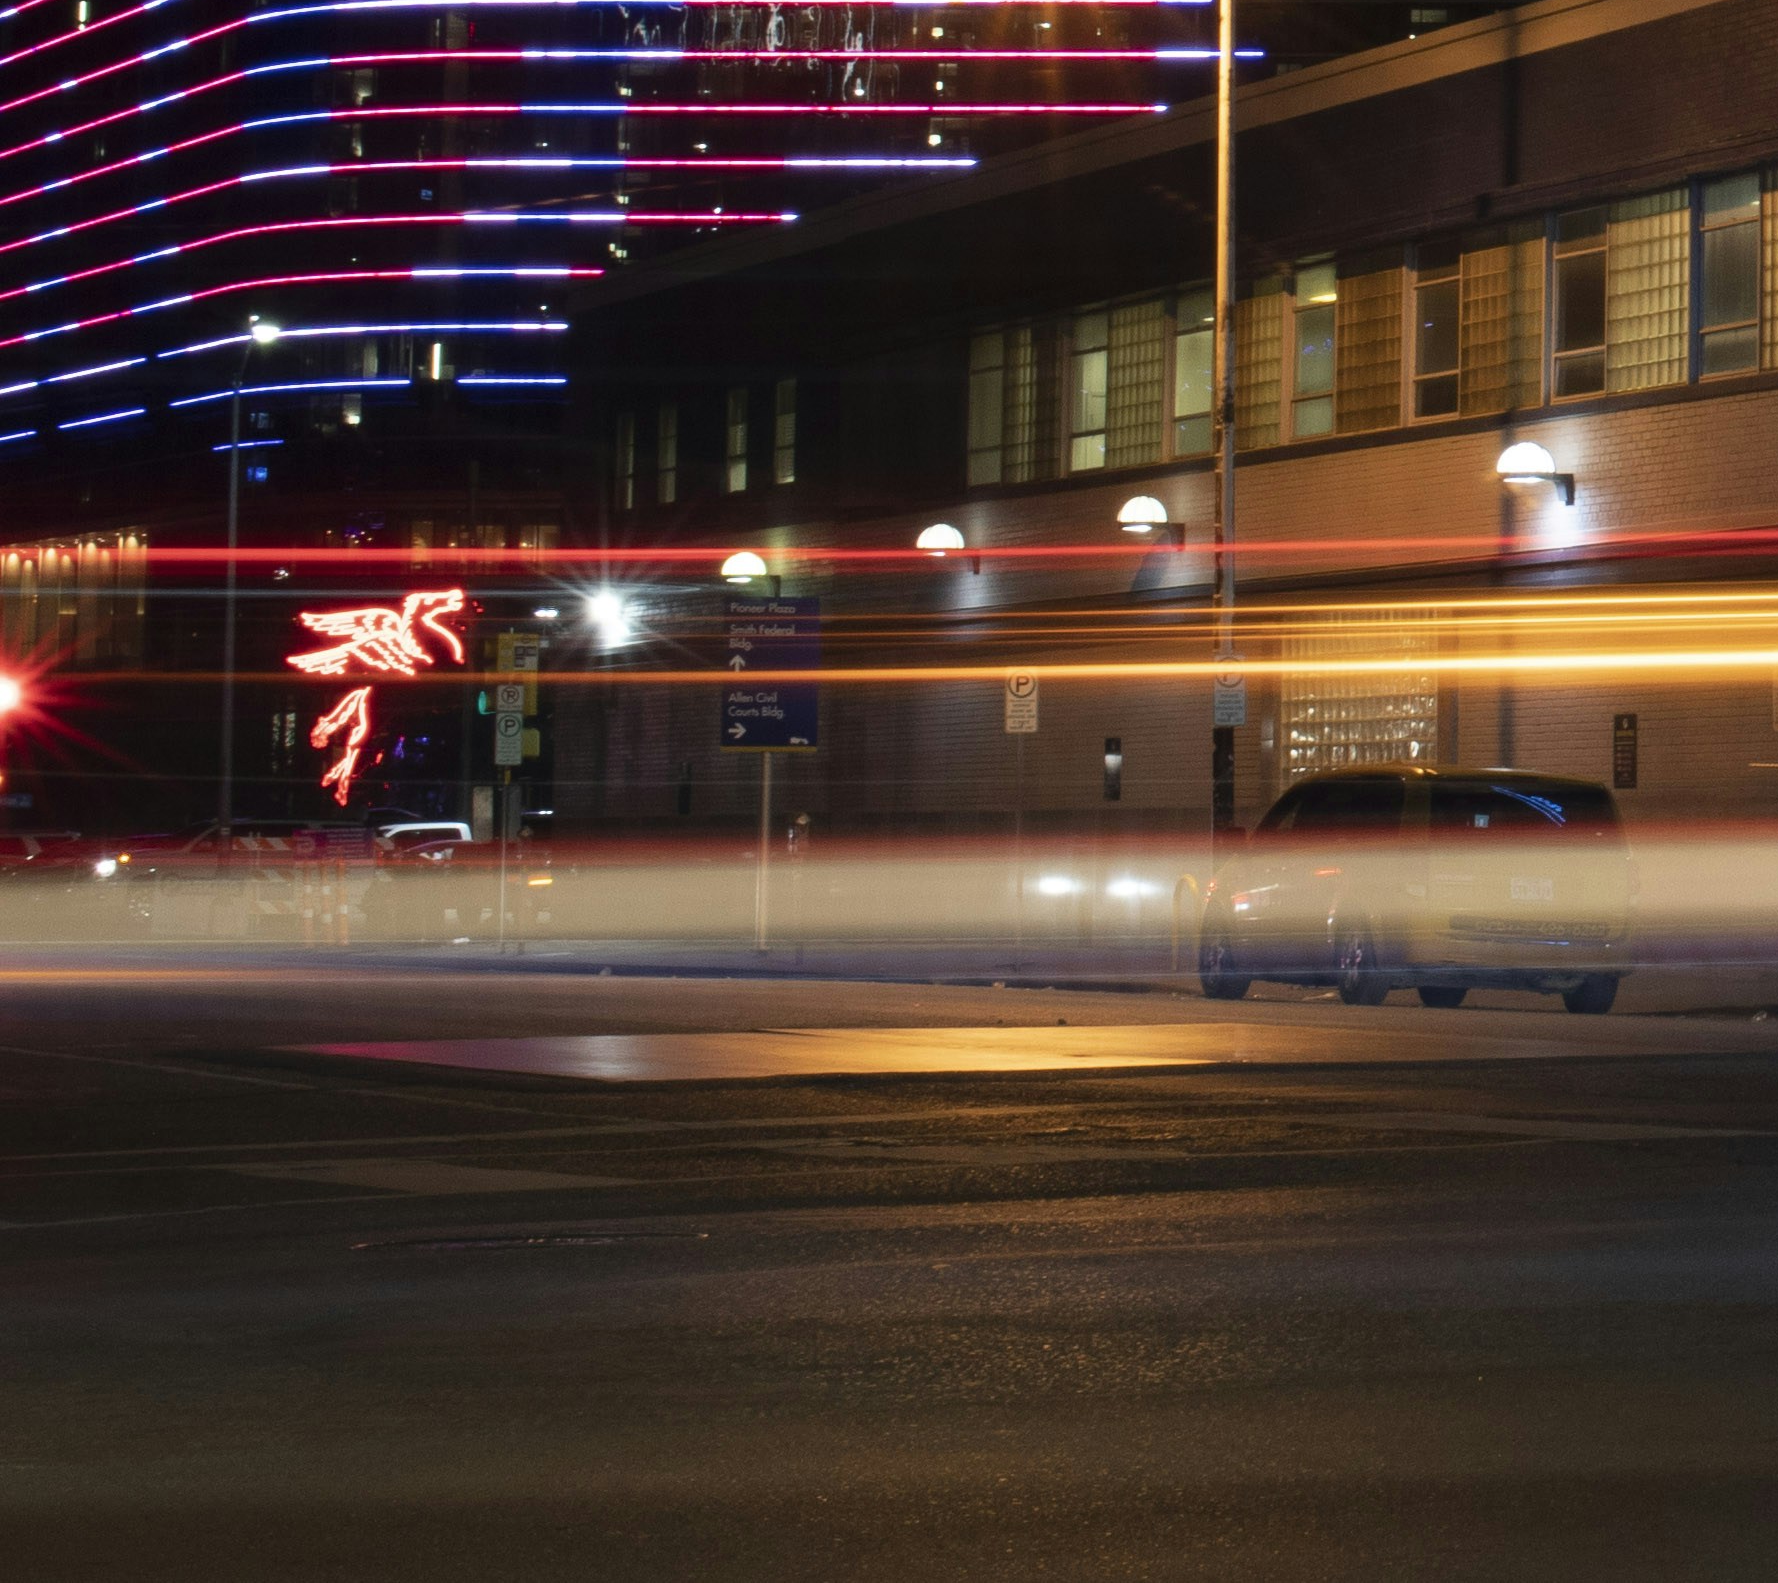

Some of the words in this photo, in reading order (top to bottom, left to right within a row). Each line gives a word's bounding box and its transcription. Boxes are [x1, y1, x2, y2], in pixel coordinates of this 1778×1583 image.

[730, 602, 767, 614] Pioneer
[768, 602, 797, 614] Plaza
[729, 623, 757, 635] Smith
[758, 623, 796, 635] Federal
[727, 692, 754, 703] Allen
[754, 691, 778, 703] Civil
[727, 705, 760, 717] Courts
